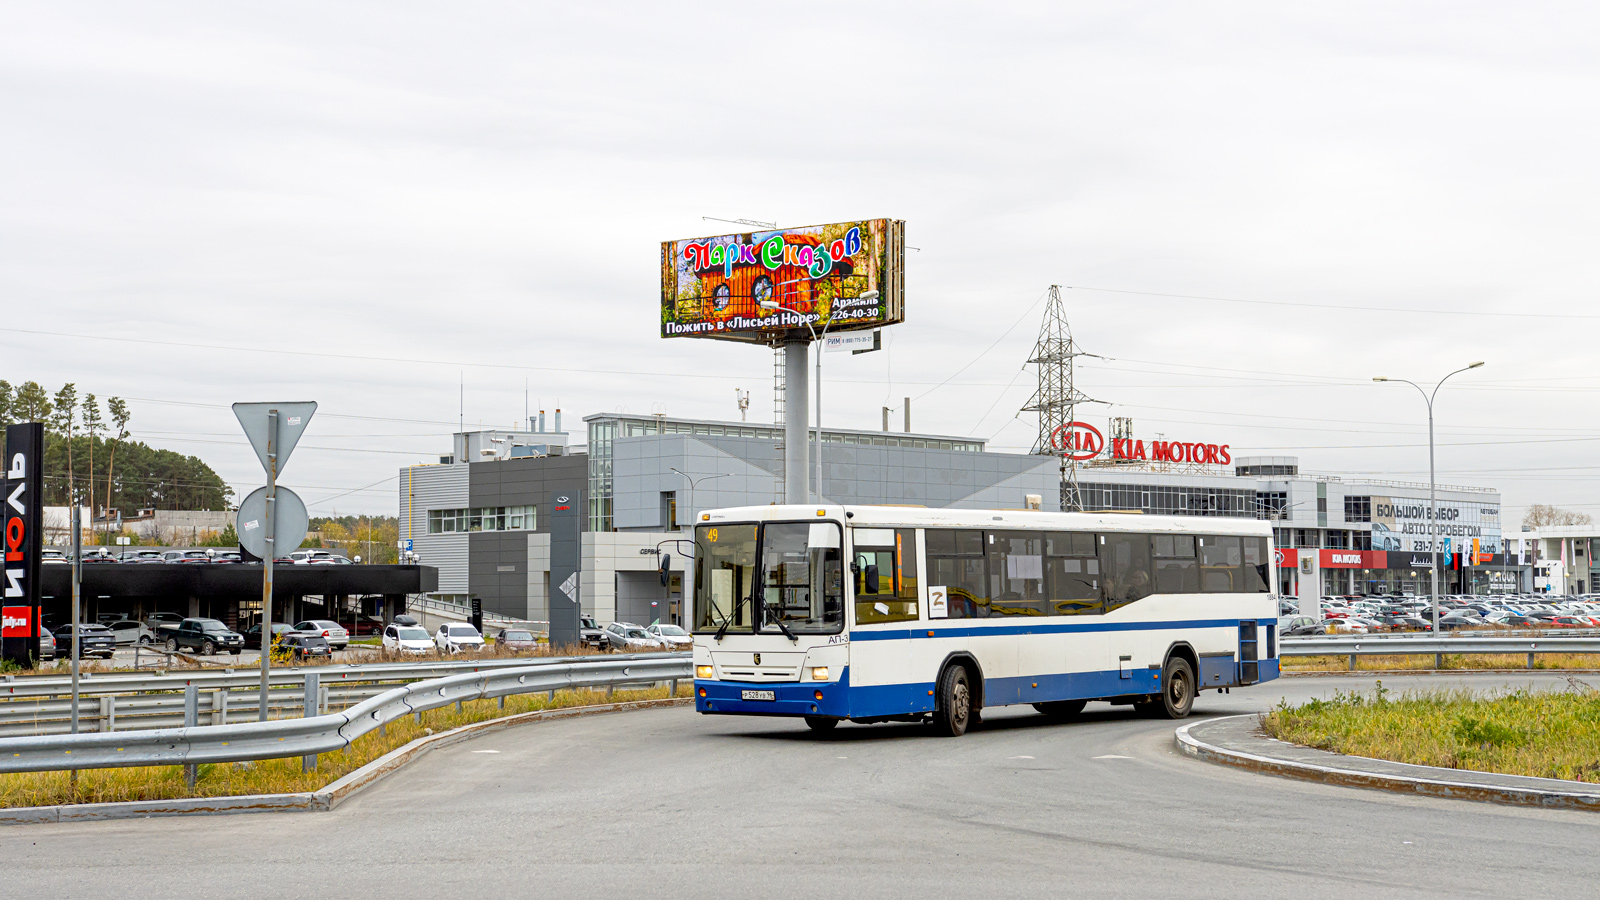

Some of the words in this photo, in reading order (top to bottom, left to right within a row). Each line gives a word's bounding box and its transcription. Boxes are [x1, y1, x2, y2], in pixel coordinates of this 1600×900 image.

[684, 239, 757, 279] Парк
[761, 226, 861, 279] Сказов
[666, 320, 715, 335] Пожить
[717, 318, 725, 330] в
[727, 314, 779, 330] «Лисьей
[781, 312, 821, 326] Норе»
[827, 338, 840, 346] РИМ
[1112, 437, 1147, 461] KIA
[1152, 440, 1232, 466] MOTORS
[1377, 504, 1425, 520] БОЛЬШОЙ
[1426, 506, 1459, 521] ВЫБОР
[708, 528, 718, 542] 49
[1401, 522, 1426, 535] АВТО
[2, 615, 27, 629] july.ru
[828, 634, 849, 645] АП-3
